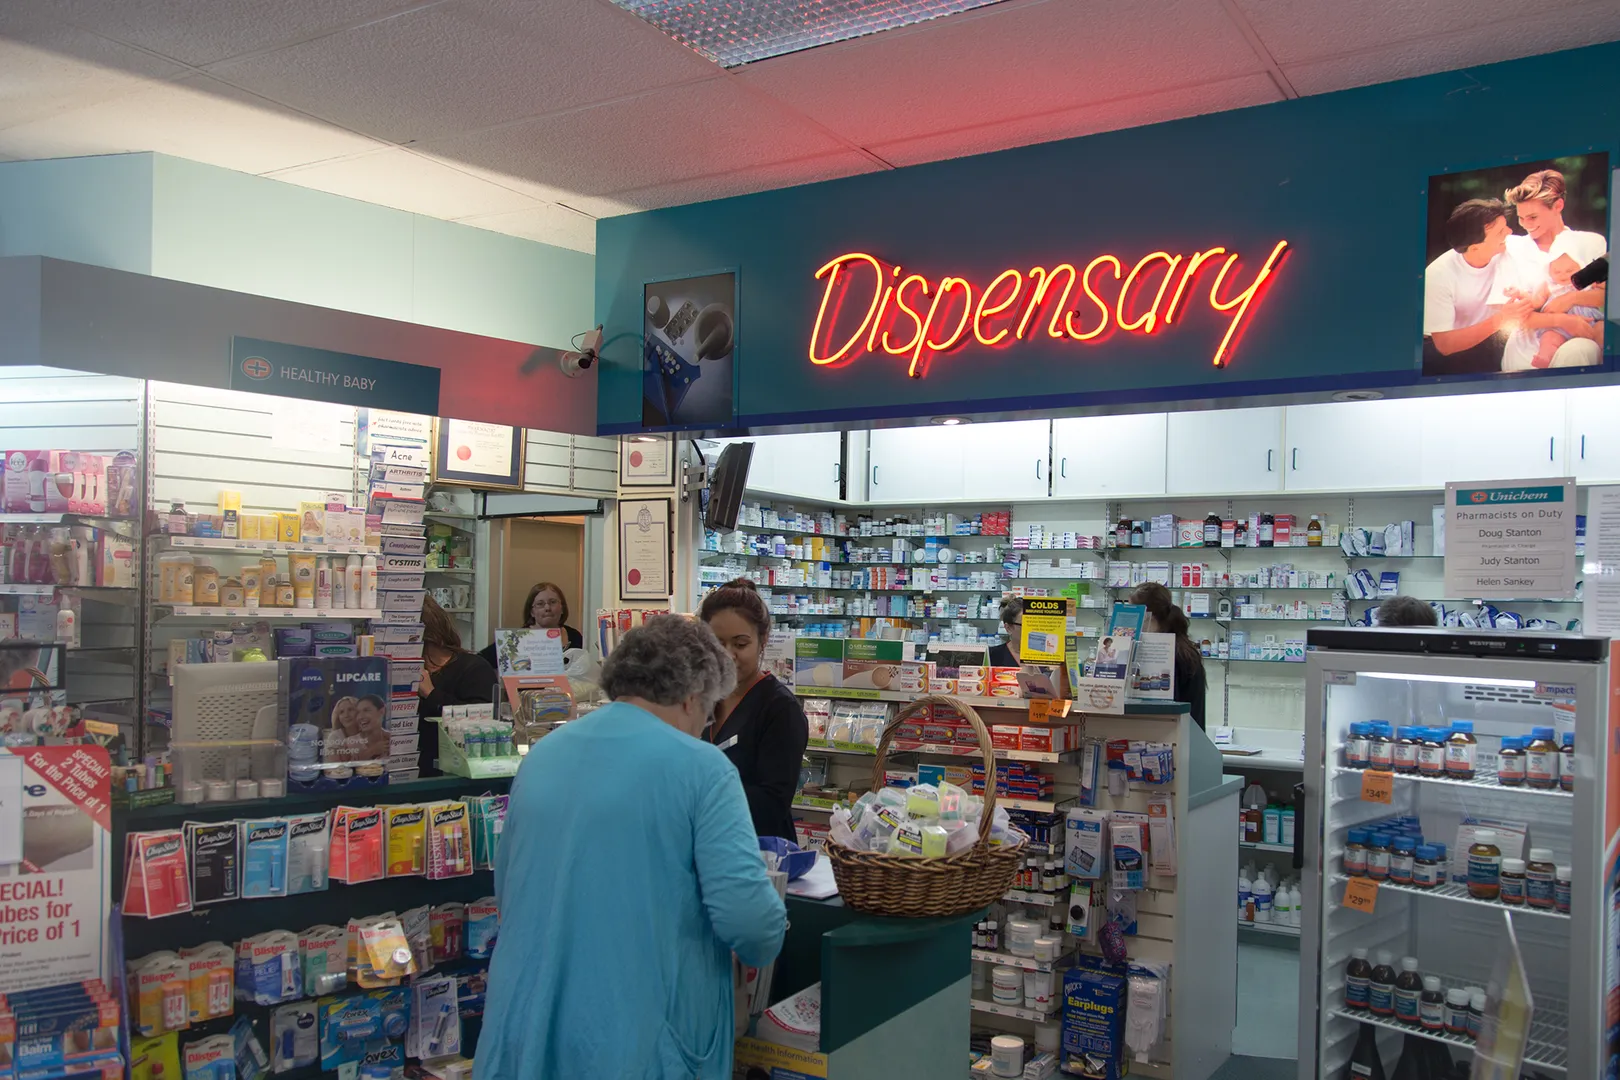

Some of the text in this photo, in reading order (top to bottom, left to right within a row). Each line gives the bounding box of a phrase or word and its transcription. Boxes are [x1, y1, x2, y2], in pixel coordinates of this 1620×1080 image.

[808, 240, 1288, 377] Dispensary
[280, 366, 377, 391] HEALTHY BABY
[391, 450, 413, 462] Acne
[389, 468, 423, 478] ARTHRITIS
[1489, 490, 1549, 502] Unichem
[1456, 510, 1518, 520] Pharmacists
[1538, 509, 1564, 520] Duty
[1478, 528, 1542, 538] Doug Stanton
[388, 542, 420, 550] Constipation
[388, 559, 422, 567] CYSTITIS
[1480, 556, 1540, 566] Judy Stanton
[1476, 578, 1535, 588] Helen Sankey
[336, 672, 381, 682] LIPCARE
[72, 749, 109, 779] SPECIAL!
[60, 757, 98, 789] 2 Tubes
[29, 752, 107, 814] For the Price of 1
[350, 815, 378, 828] ChapStick
[391, 813, 422, 825] ChapStick
[435, 809, 463, 822] ChapStick
[250, 827, 284, 839] ChapStick
[291, 822, 326, 835] ChapStick
[199, 832, 234, 845] ChapStick
[146, 840, 180, 856] ChapStick
[0, 878, 64, 901] ECIAL!
[46, 900, 72, 918] for
[471, 906, 497, 914] Blistex
[430, 912, 454, 920] Blistex
[46, 920, 64, 940] of
[71, 920, 80, 937] 1
[254, 943, 286, 957] Blistex
[308, 940, 336, 950] Blistex
[189, 959, 222, 971] Blistex
[141, 972, 176, 984] Blistex
[1067, 996, 1114, 1014] Earplugs
[188, 1050, 221, 1063] Blistex
[750, 1041, 775, 1055] Health
[776, 1048, 823, 1065] Information
